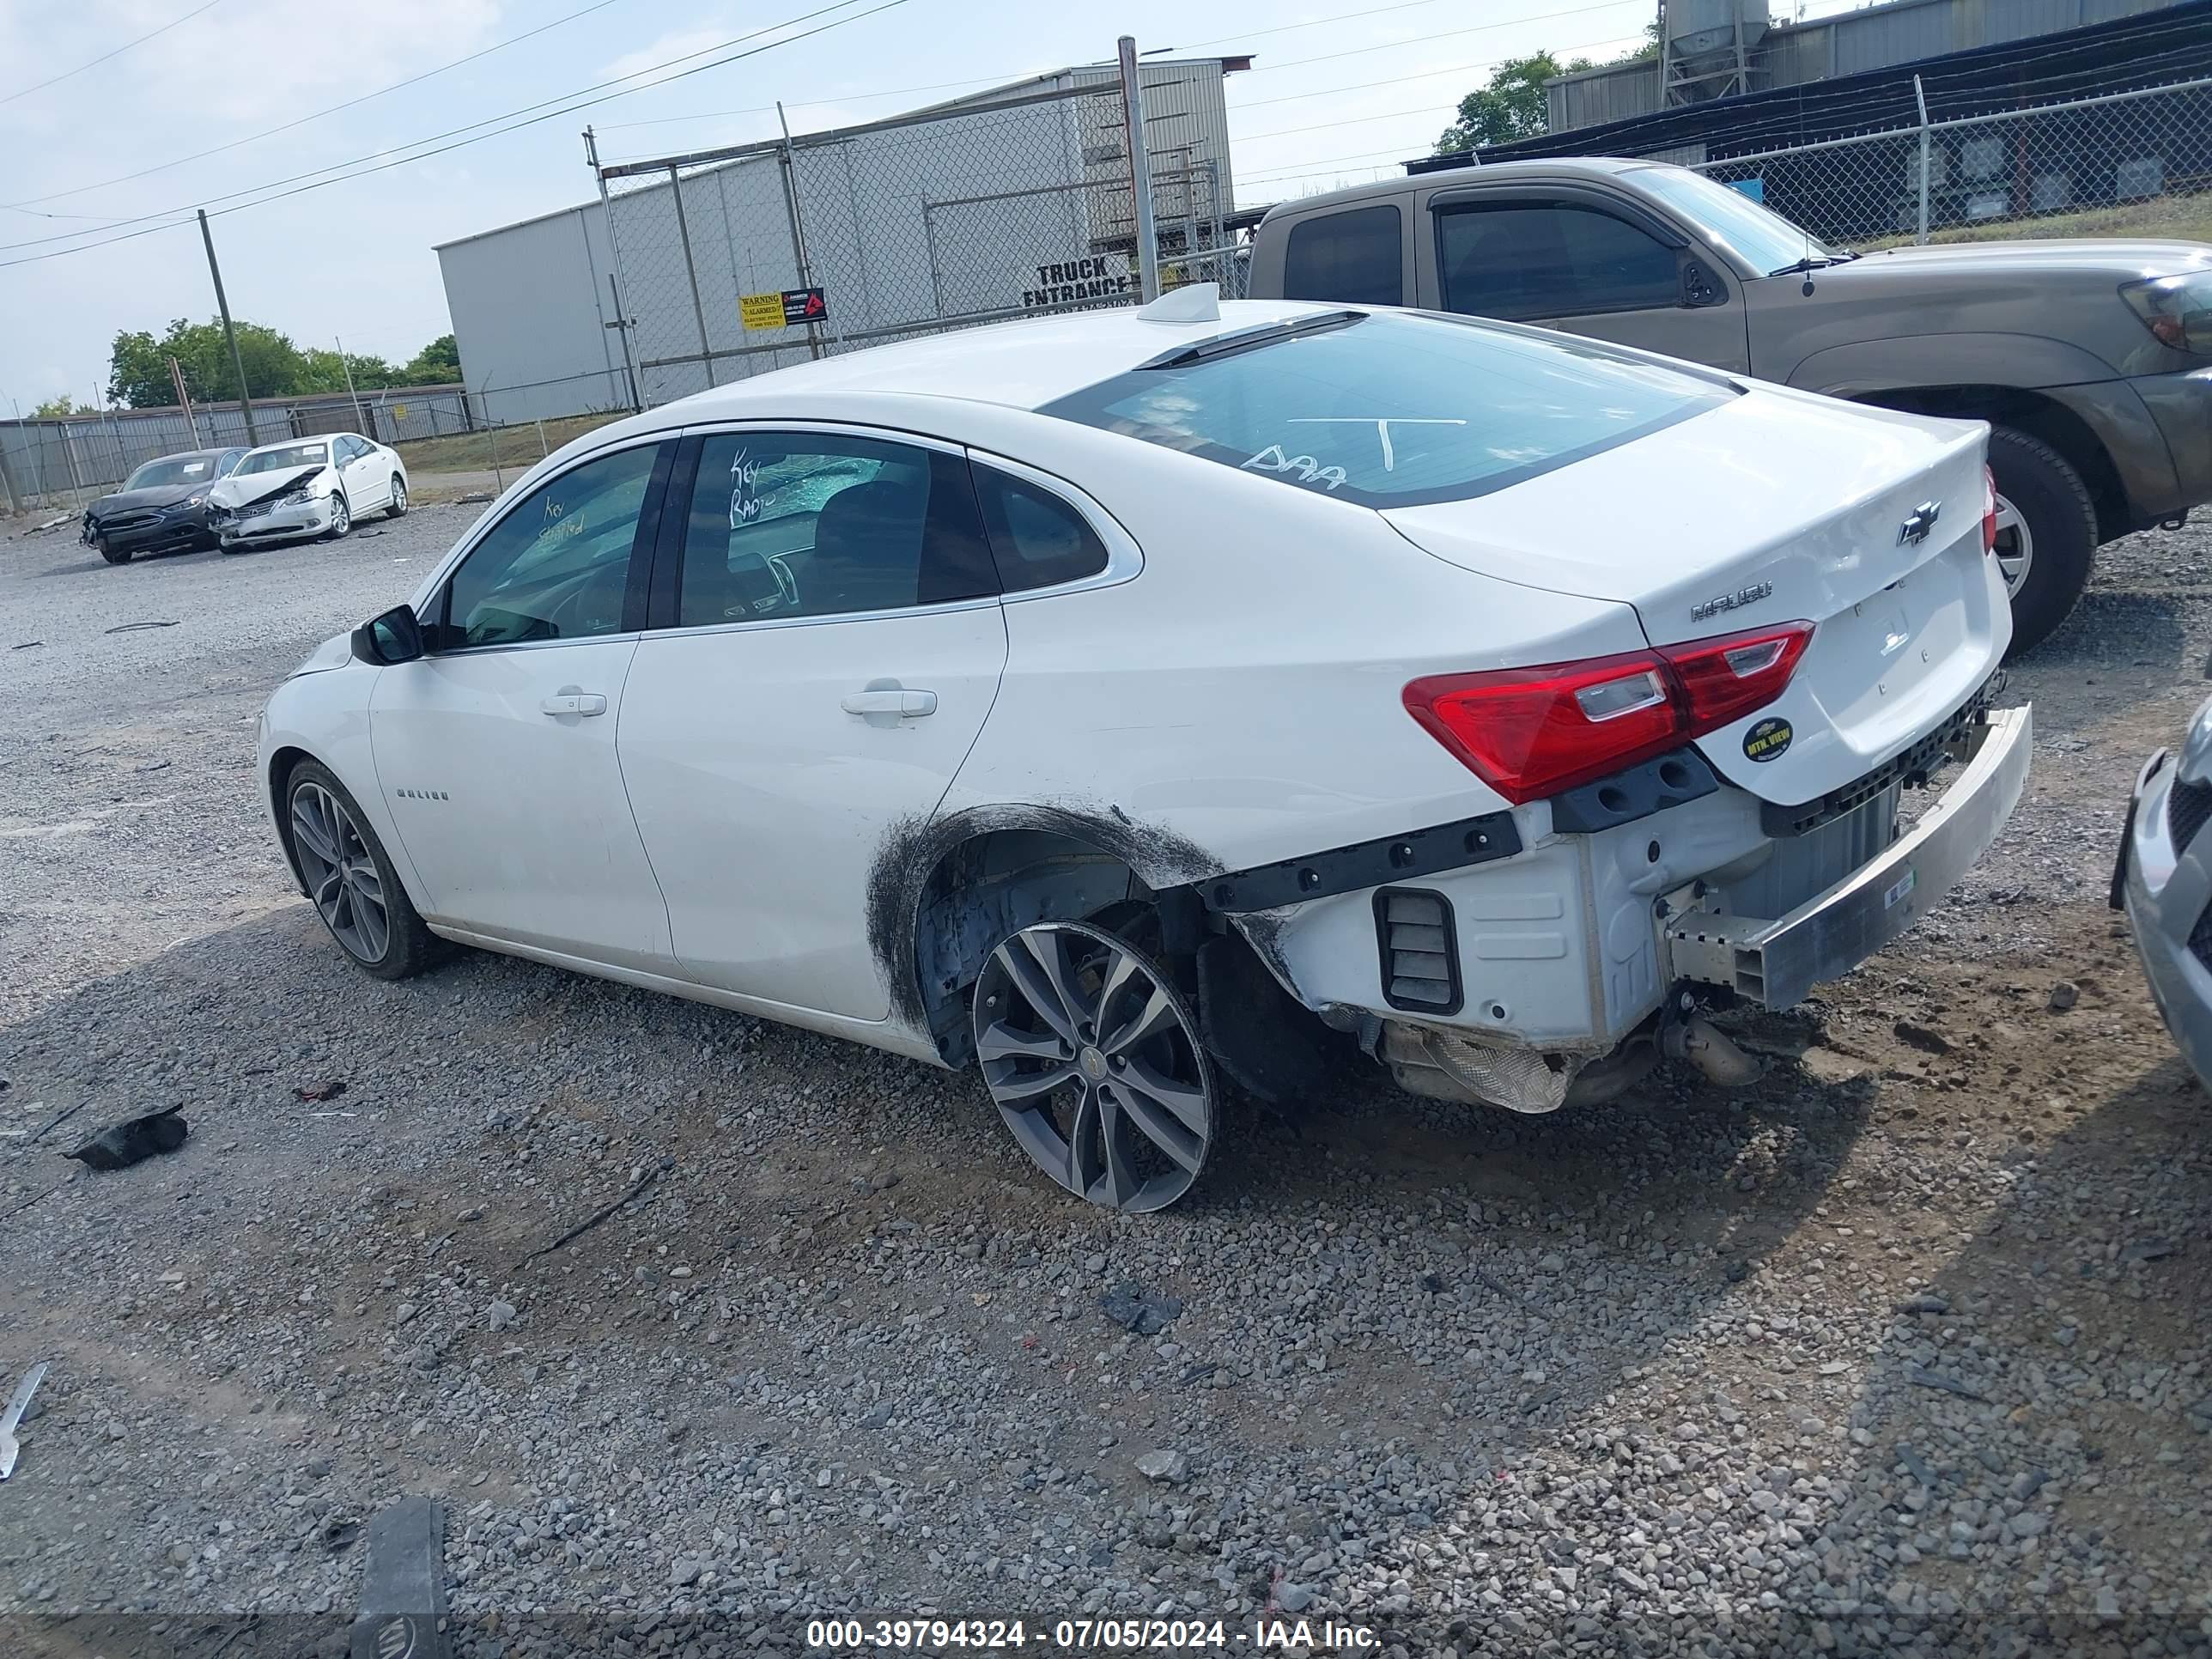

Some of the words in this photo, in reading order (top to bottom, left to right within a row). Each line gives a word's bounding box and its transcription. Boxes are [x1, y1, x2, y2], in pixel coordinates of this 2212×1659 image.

[1036, 257, 1108, 286] TRUCK
[742, 295, 780, 306] WARNING
[1023, 276, 1127, 307] ENTRANCE
[1690, 580, 1773, 623] MALIBU
[397, 788, 449, 801] MALIBU
